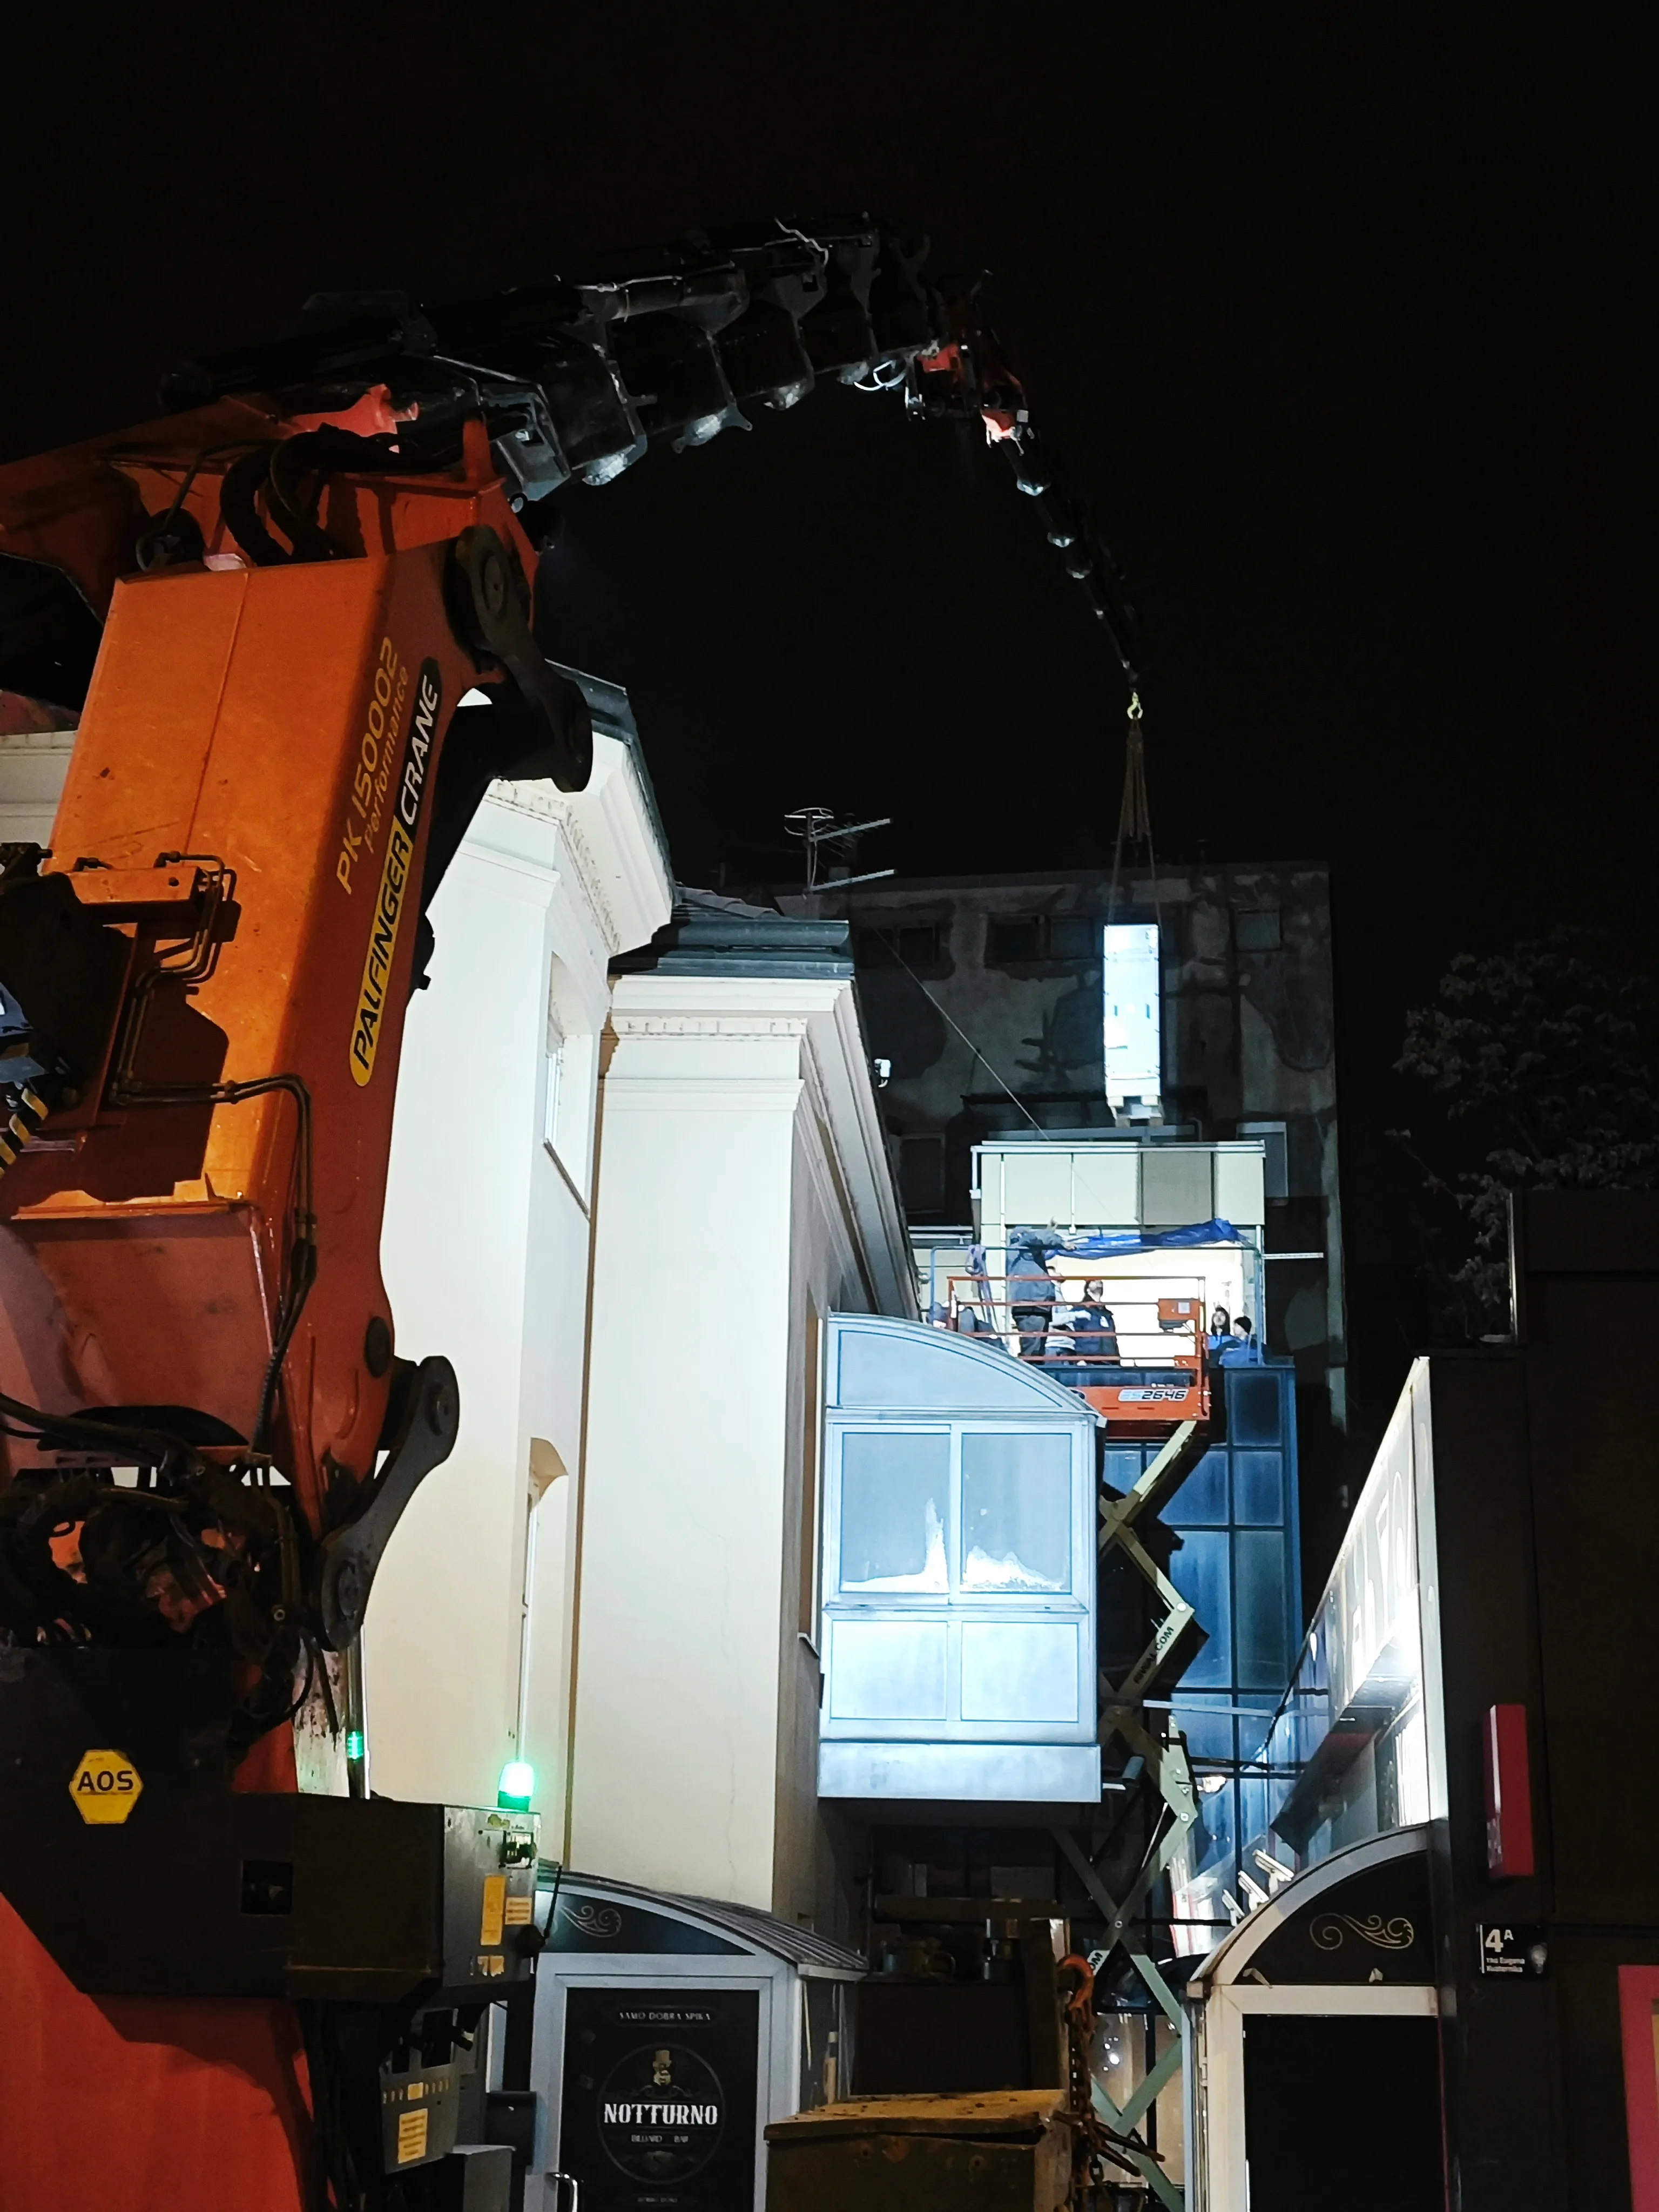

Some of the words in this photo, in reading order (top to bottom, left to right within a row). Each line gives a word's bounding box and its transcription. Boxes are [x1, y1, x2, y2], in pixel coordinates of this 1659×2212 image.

[336, 817, 362, 895] PK
[352, 636, 397, 819] 150002
[354, 831, 409, 1069] PALFINGER
[401, 675, 438, 825] CRANE
[77, 1770, 133, 1791] AOS
[604, 2103, 718, 2126] NOTTURNO
